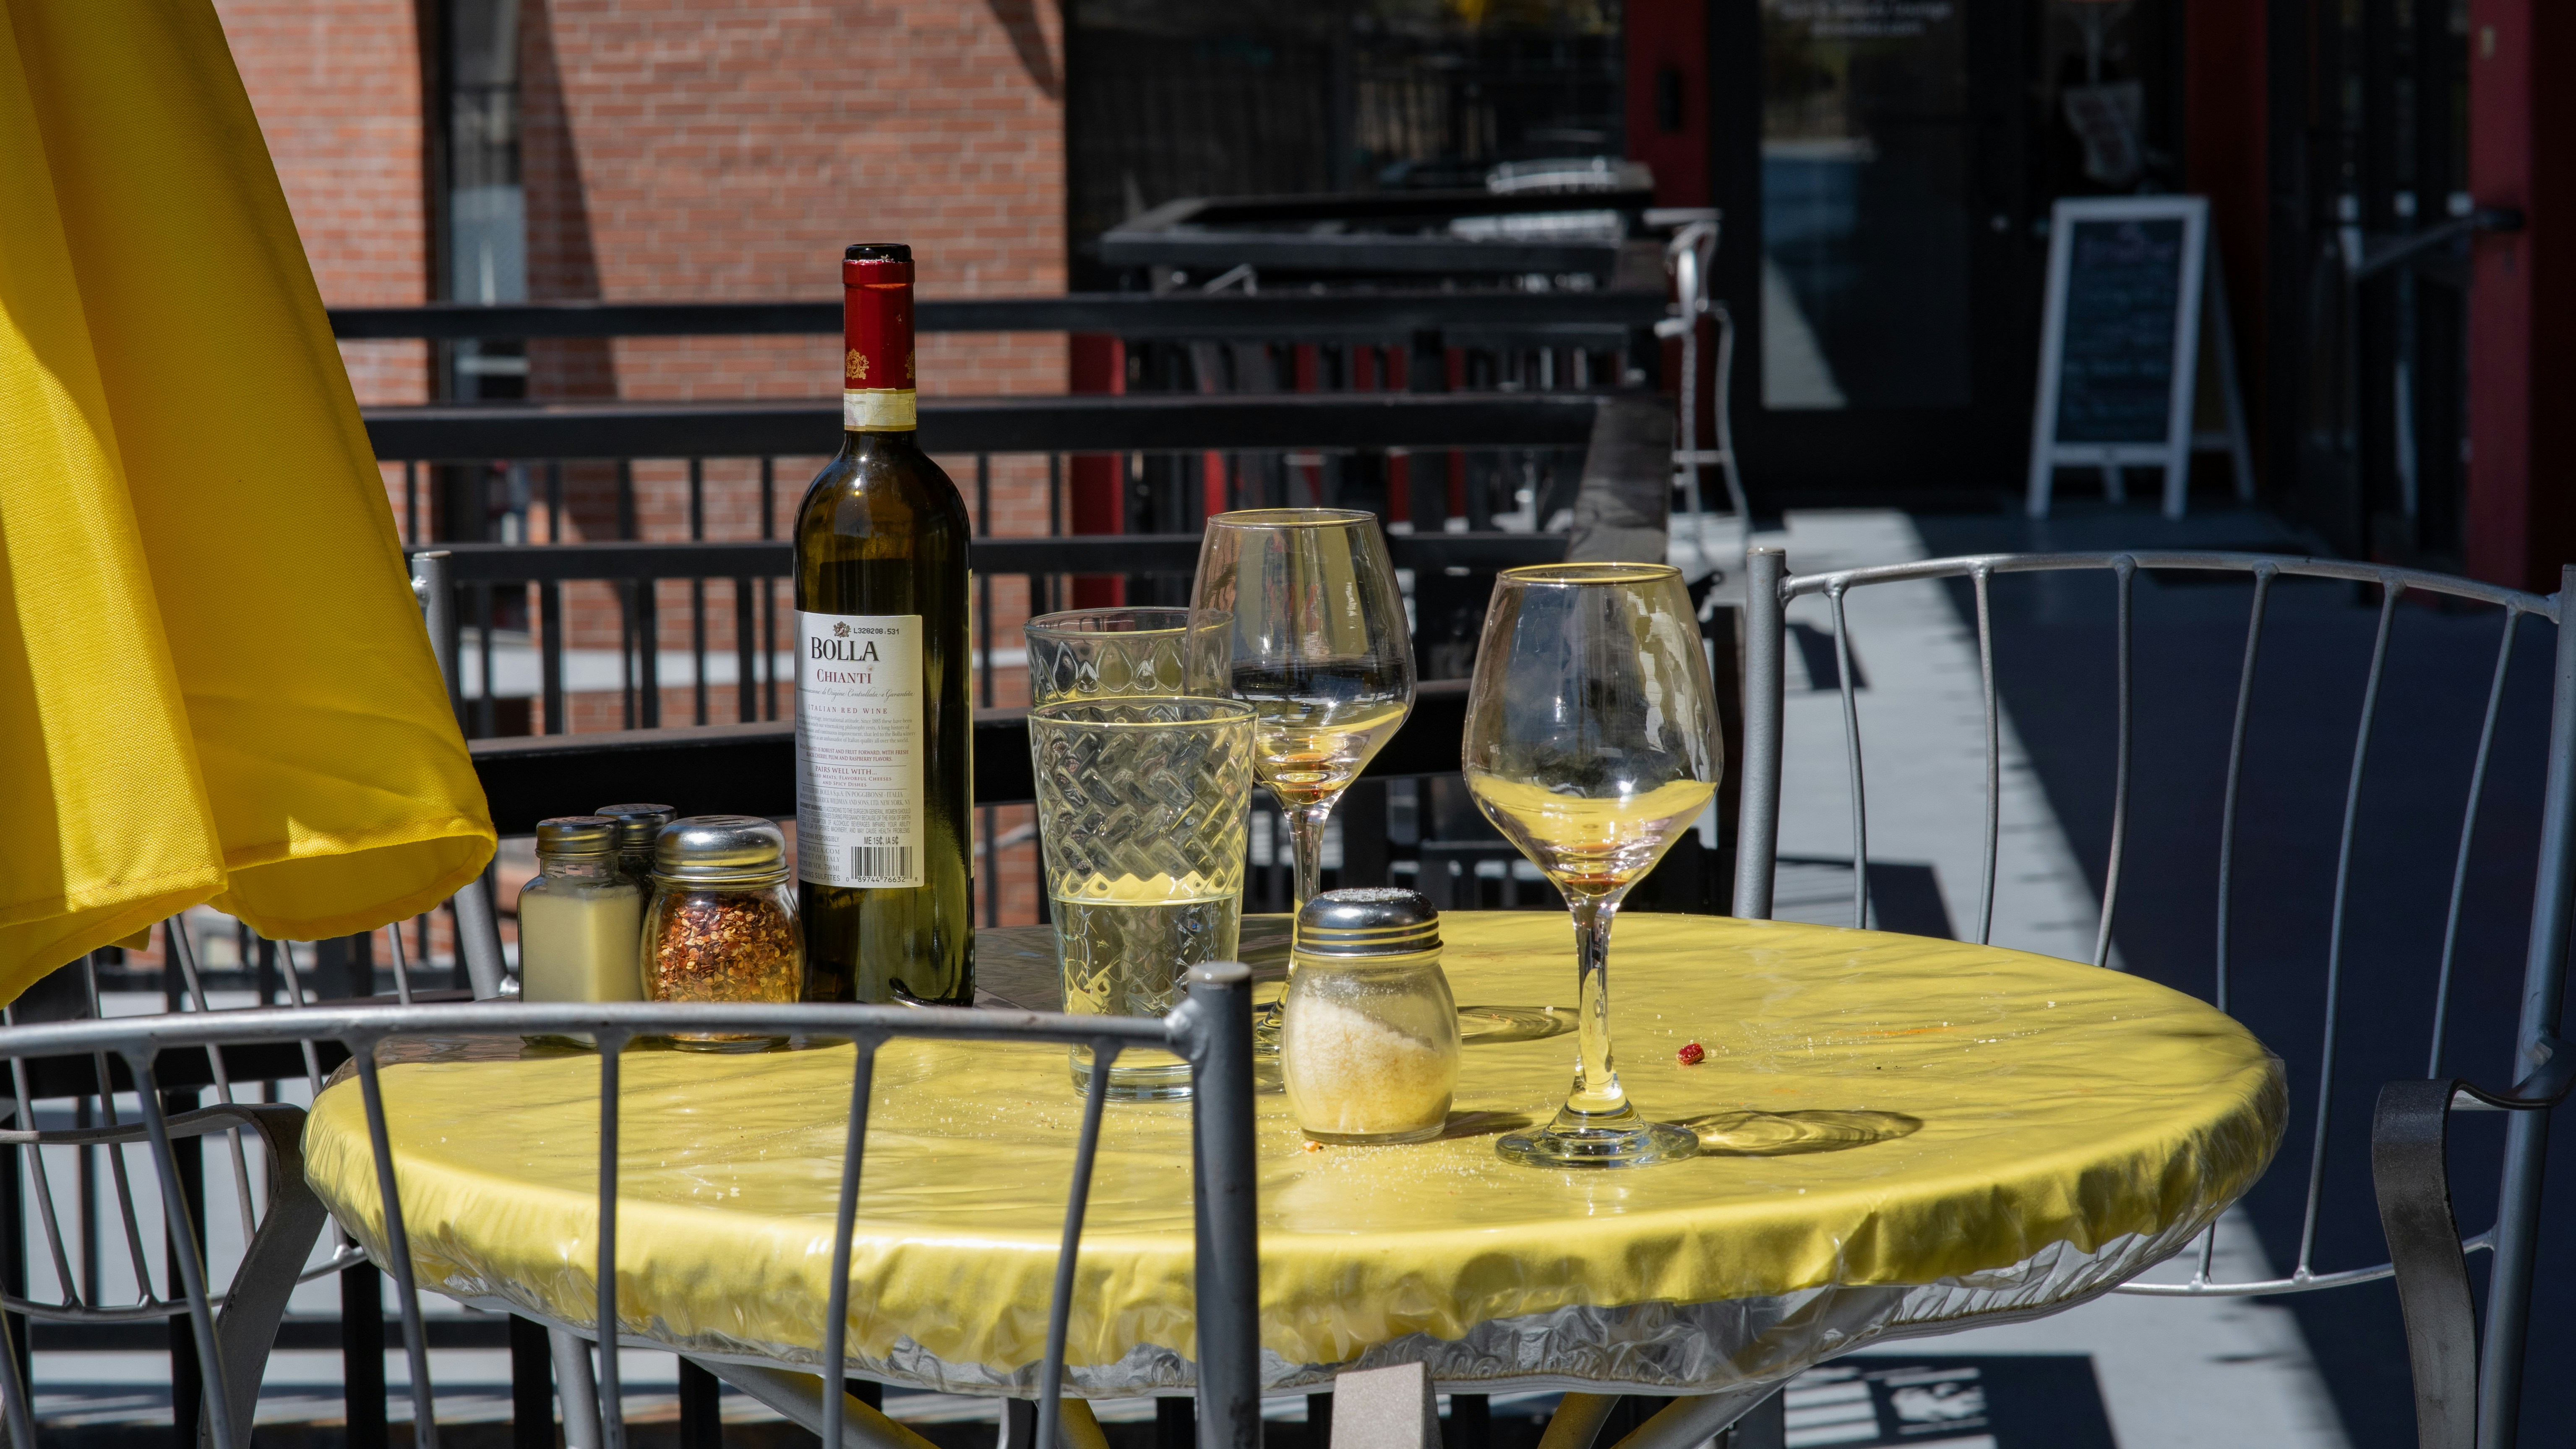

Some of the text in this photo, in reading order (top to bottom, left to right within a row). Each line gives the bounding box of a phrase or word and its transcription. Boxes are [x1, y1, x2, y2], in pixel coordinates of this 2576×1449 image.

[811, 637, 880, 662] BOLLA
[817, 669, 872, 684] CHIANTI
[827, 688, 846, 702] Origine
[846, 687, 879, 697] Controllata
[884, 688, 915, 703] Garantita
[815, 872, 840, 881] SULFITES
